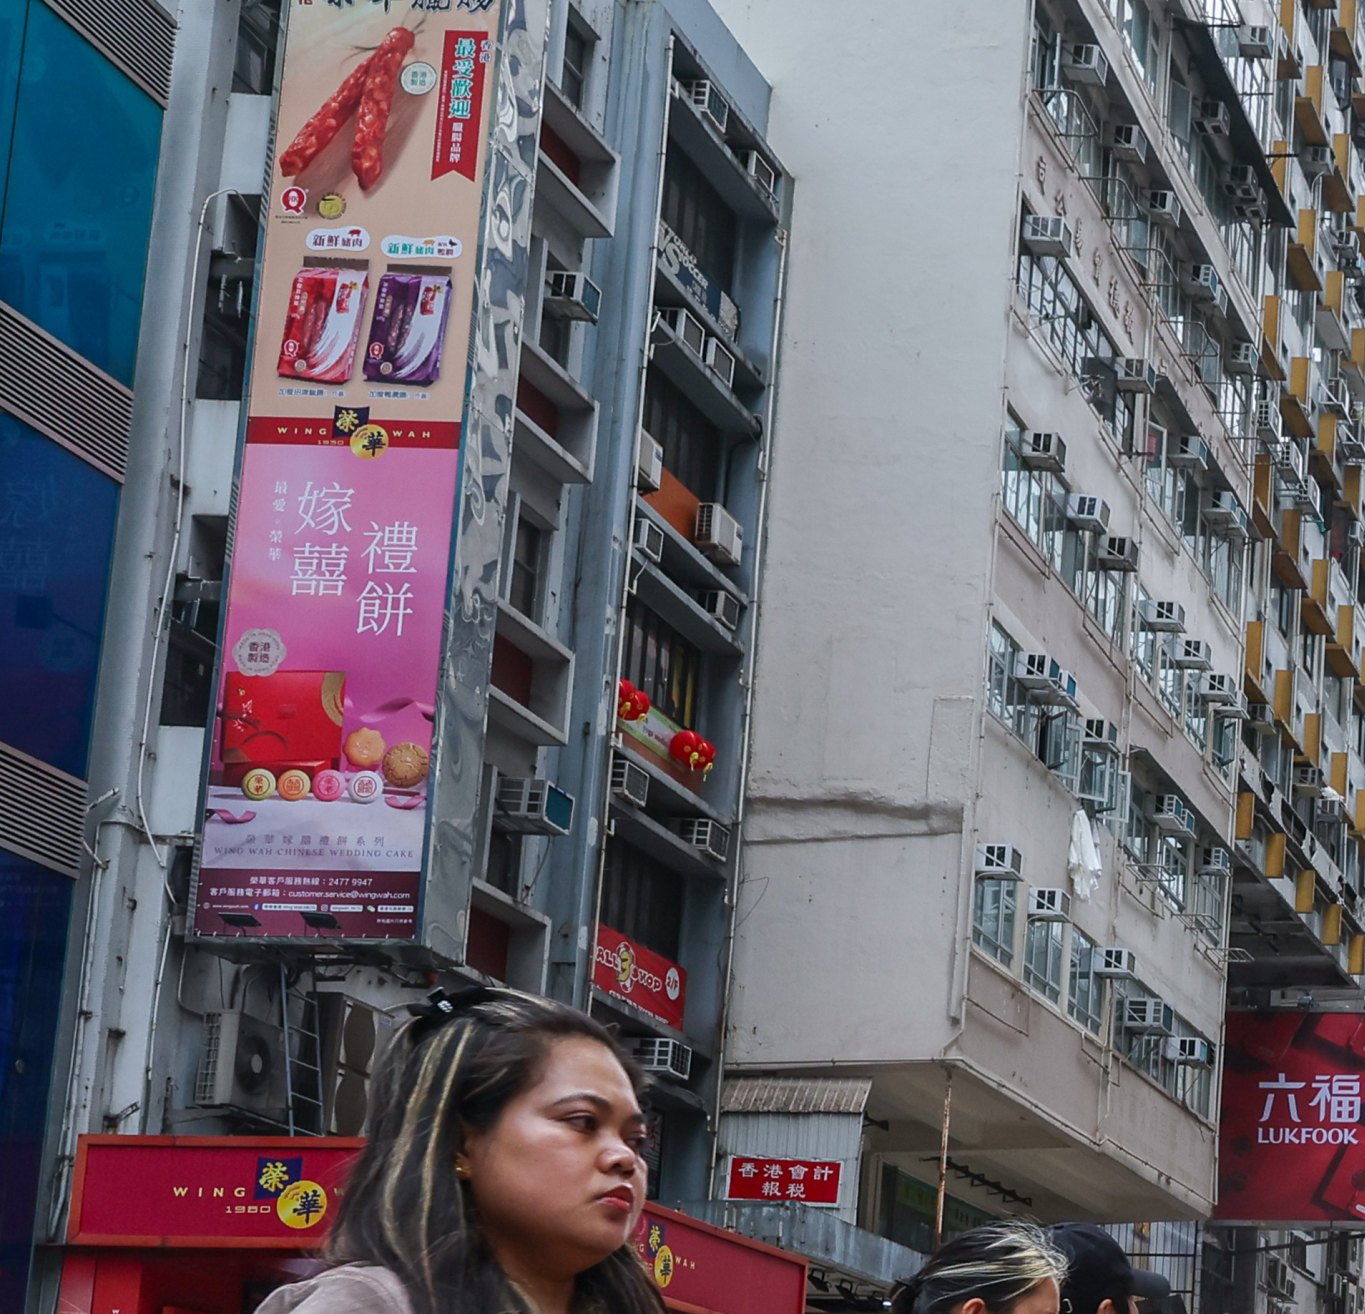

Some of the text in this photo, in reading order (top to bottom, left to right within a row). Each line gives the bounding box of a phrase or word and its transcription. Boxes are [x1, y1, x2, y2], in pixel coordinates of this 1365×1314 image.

[336, 410, 359, 433] 榮
[277, 427, 431, 438] WING WAH
[362, 431, 386, 457] 華
[290, 481, 355, 596] 嫁囍
[356, 521, 418, 636] 禮餅
[248, 641, 270, 652] 香港
[249, 848, 272, 856] WAH
[276, 848, 324, 857] CHINESE
[330, 849, 381, 858] WEDDING
[328, 878, 350, 886] 2477
[352, 878, 373, 887] 9947
[1258, 1073, 1361, 1123] 六福
[1257, 1127, 1358, 1145] LUKFOOK
[259, 1162, 289, 1192] 榮
[738, 1163, 834, 1182] 香港會計
[173, 1187, 246, 1197] WING
[293, 1190, 324, 1224] 華
[675, 1256, 695, 1270] WAH
